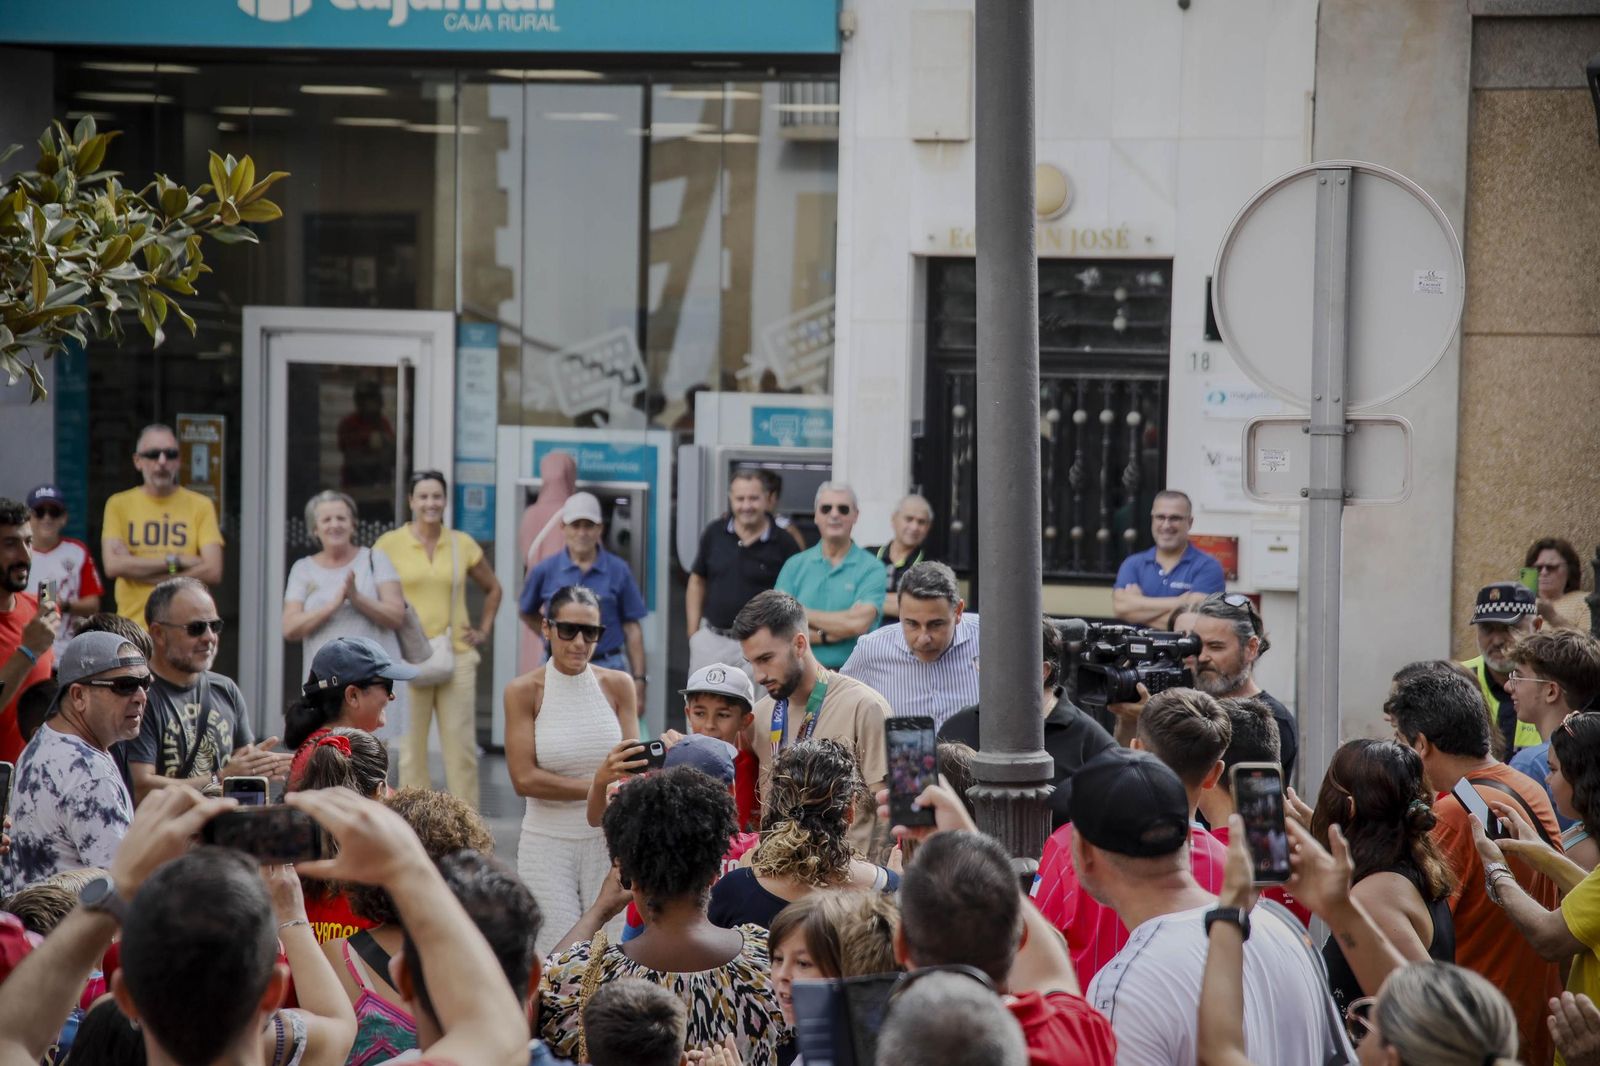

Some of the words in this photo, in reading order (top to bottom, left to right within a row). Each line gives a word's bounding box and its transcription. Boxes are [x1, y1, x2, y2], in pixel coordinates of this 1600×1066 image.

[443, 13, 493, 32] CAJA
[497, 13, 561, 32] RURAL
[1070, 221, 1130, 252] JOSÉ
[1190, 351, 1211, 372] 18
[128, 514, 188, 547] LOIS
